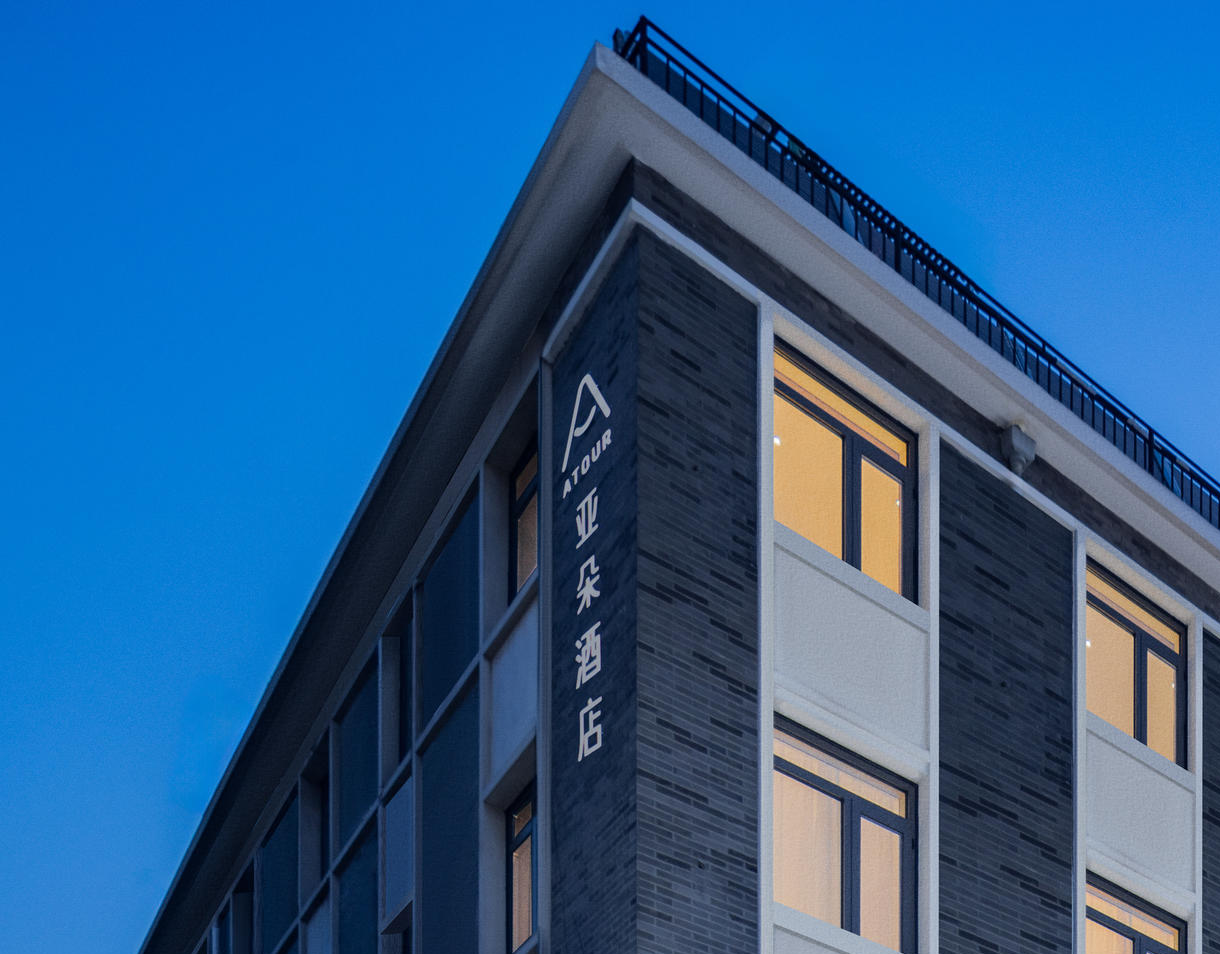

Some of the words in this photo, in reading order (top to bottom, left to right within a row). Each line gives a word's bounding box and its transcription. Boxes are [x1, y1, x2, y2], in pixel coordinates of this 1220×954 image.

[562, 428, 612, 499] ATOUR
[575, 487, 603, 762] 亚朵酒店
